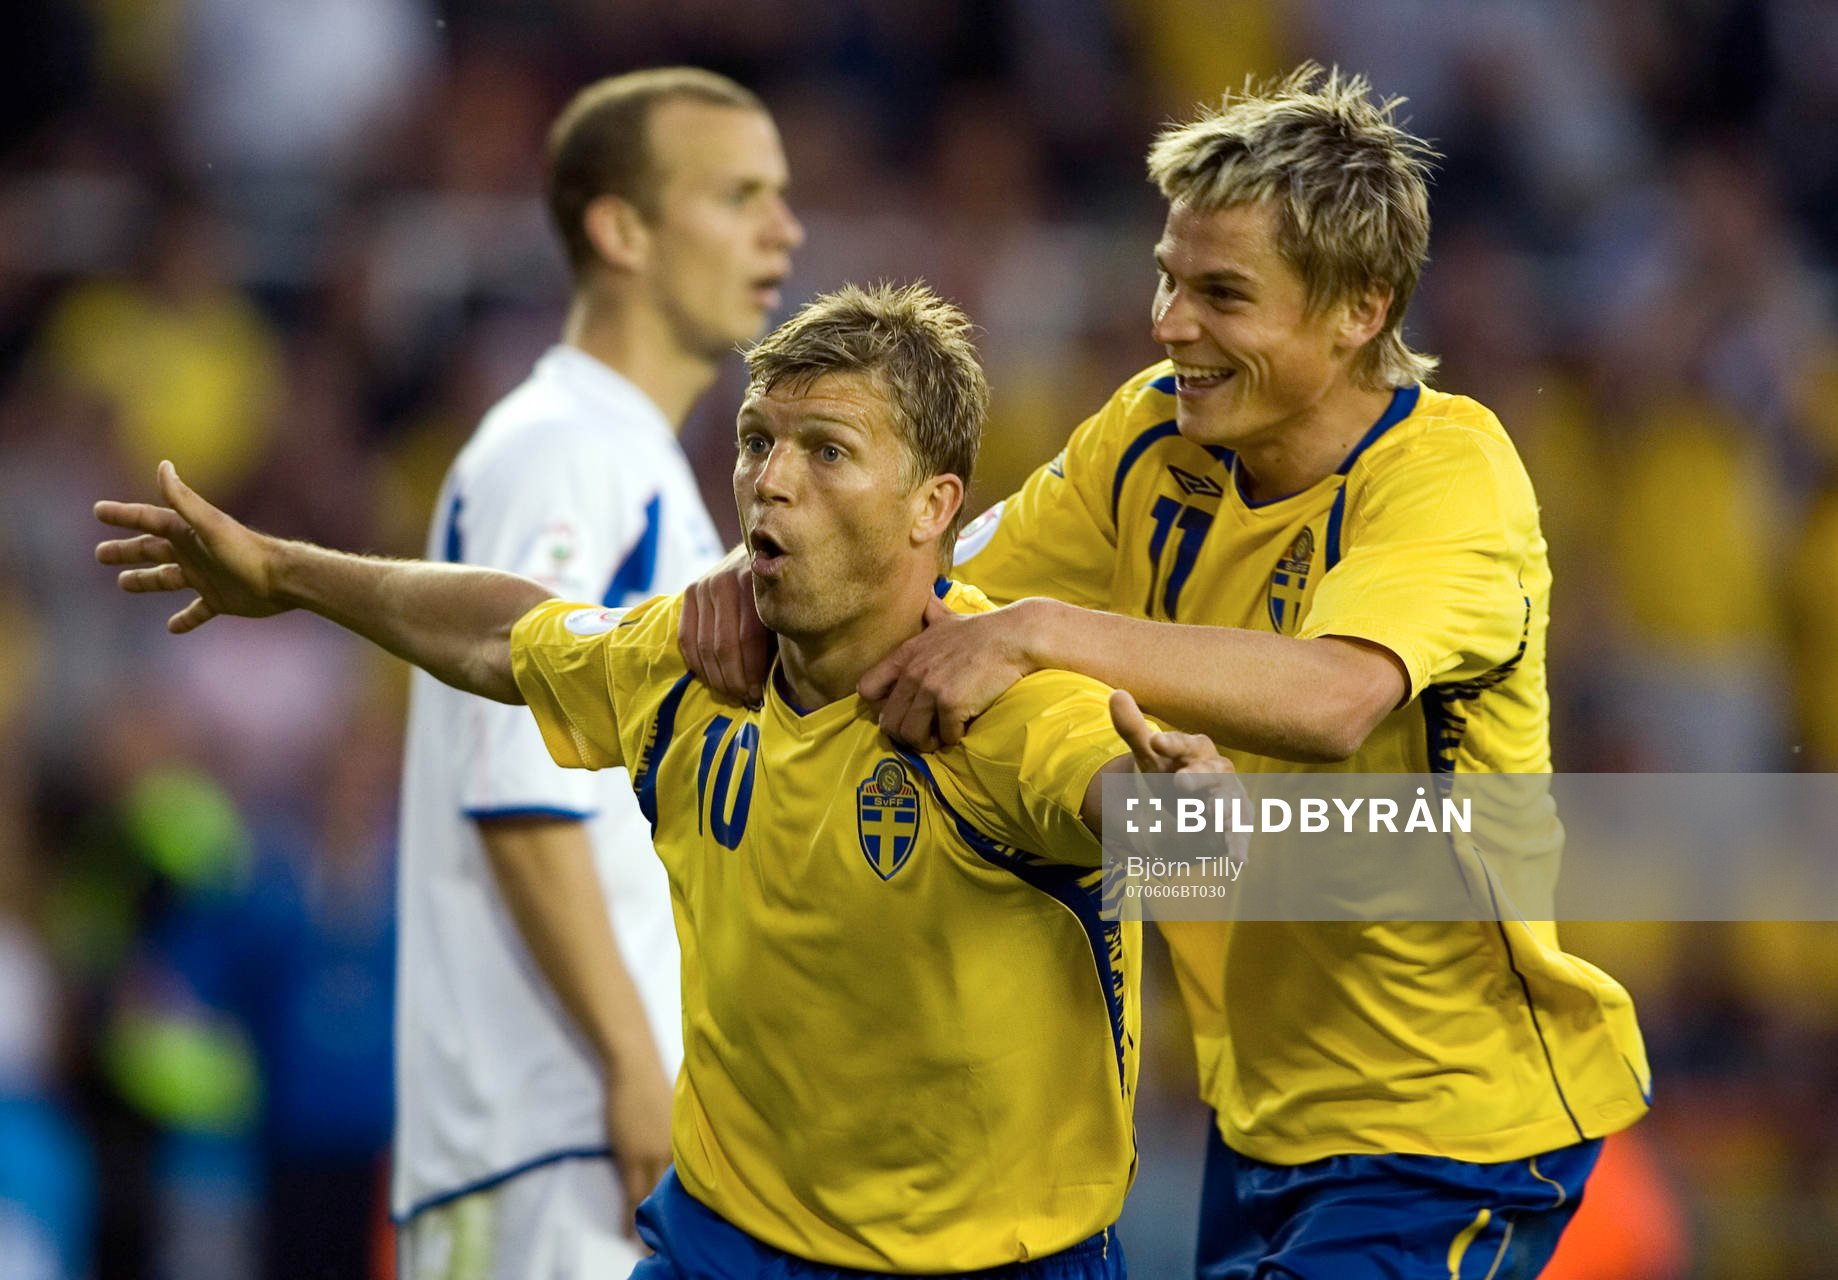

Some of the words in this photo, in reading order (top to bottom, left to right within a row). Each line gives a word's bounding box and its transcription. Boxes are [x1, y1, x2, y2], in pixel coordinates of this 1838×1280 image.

[1144, 495, 1214, 623] 11
[698, 714, 760, 851] 10
[874, 798, 904, 807] SvFF
